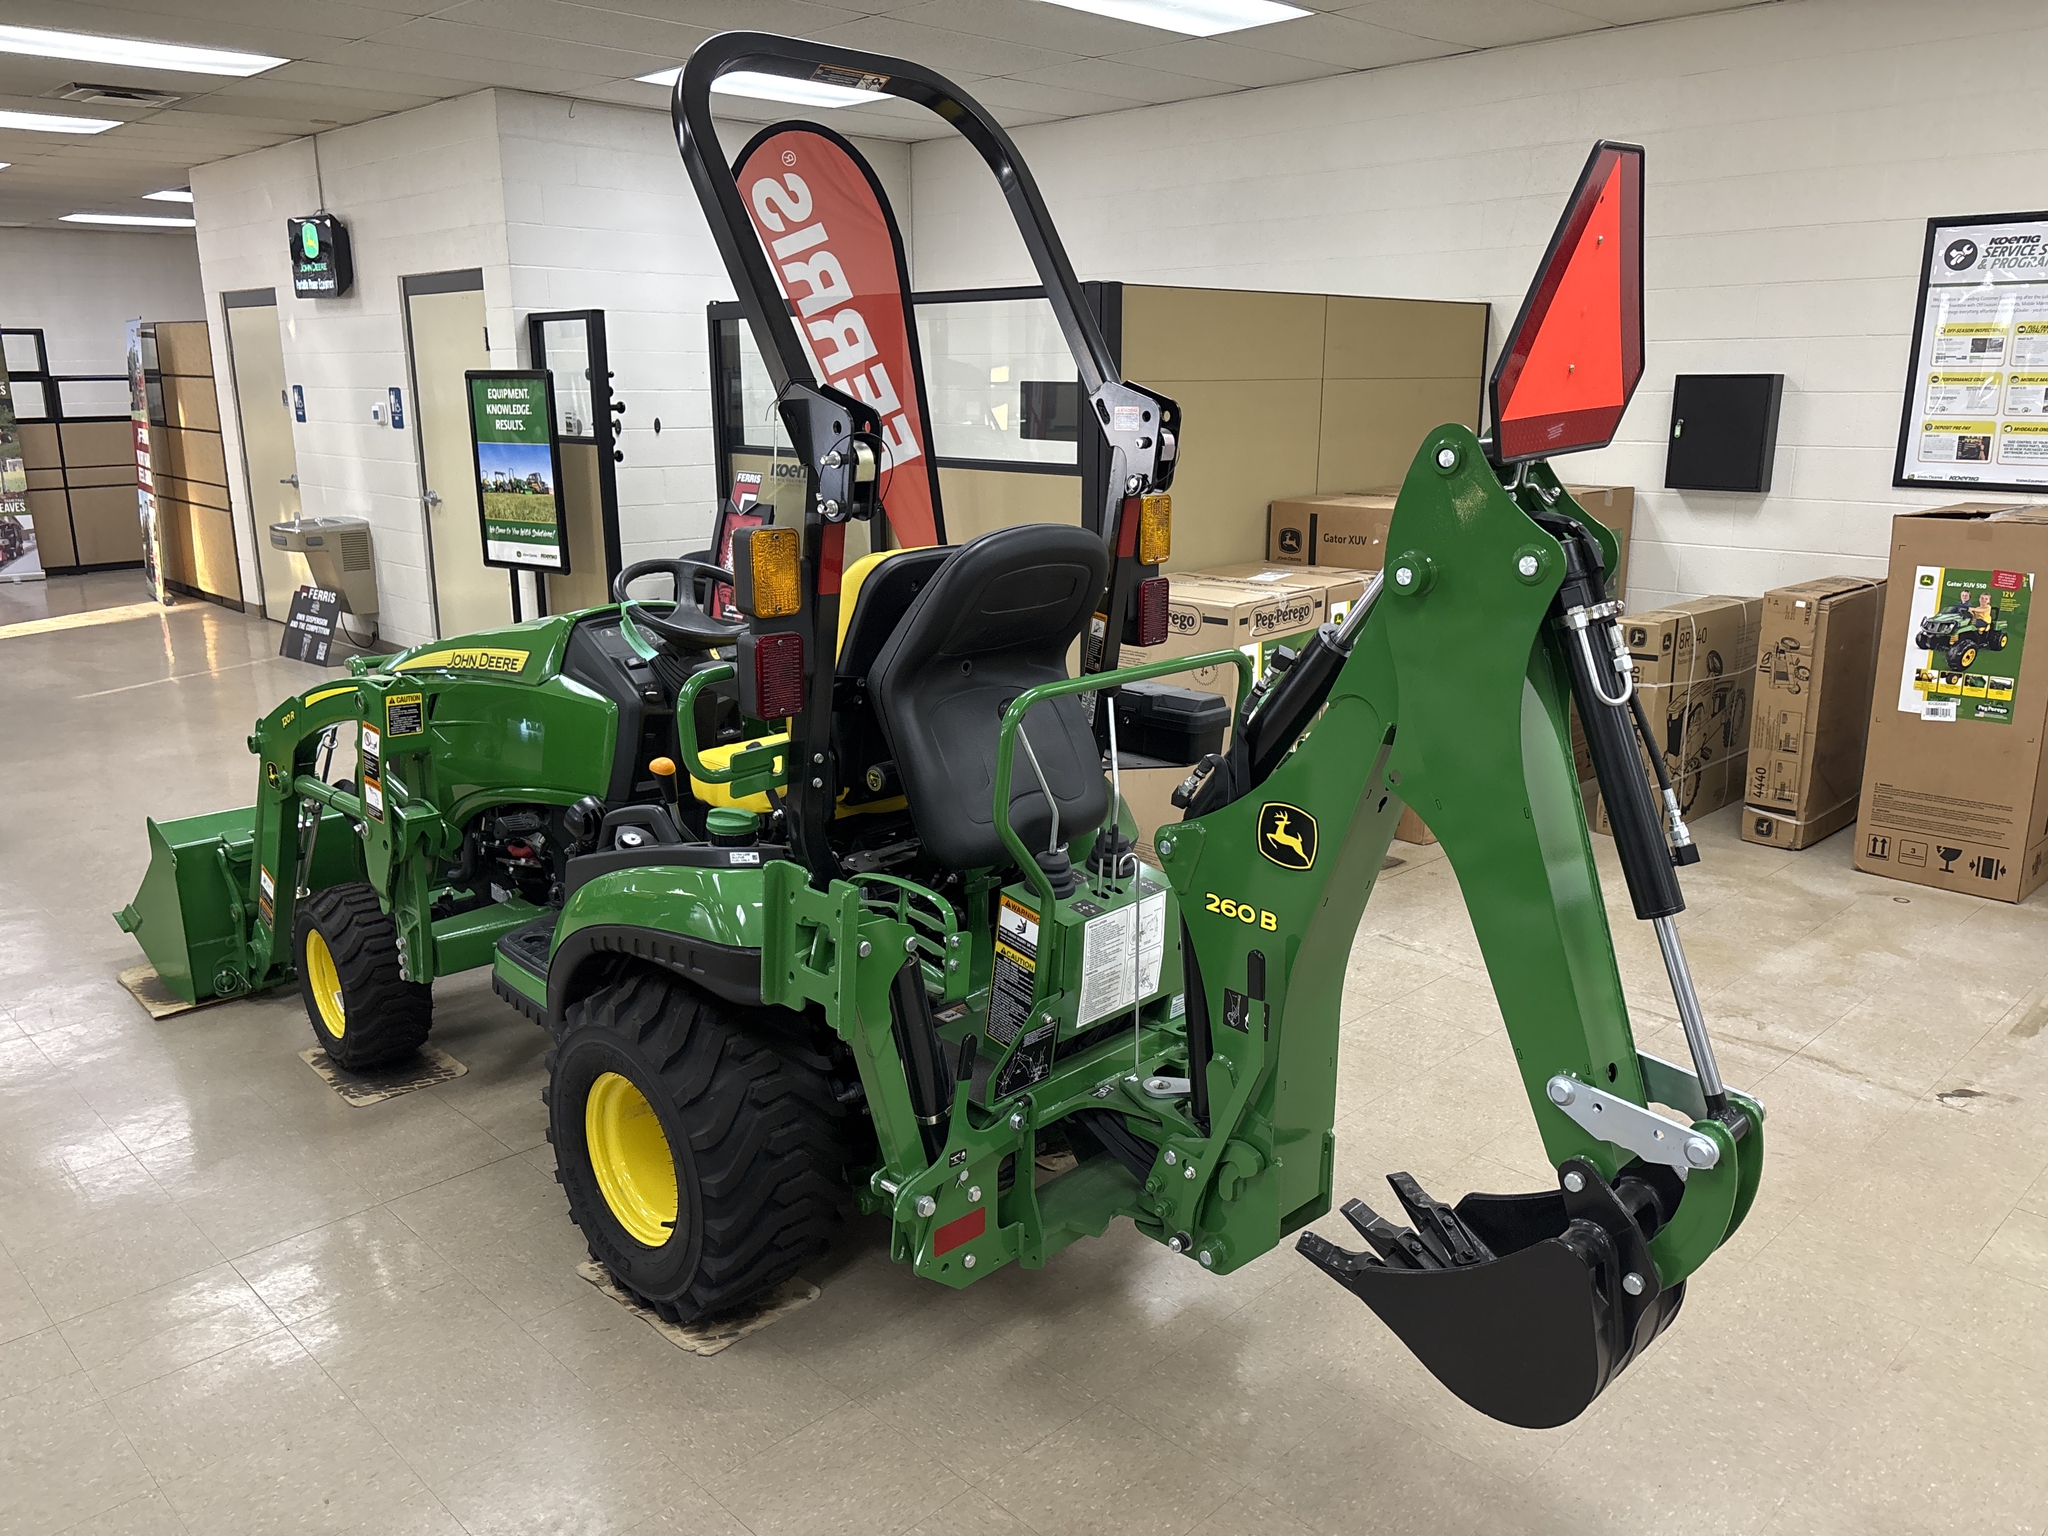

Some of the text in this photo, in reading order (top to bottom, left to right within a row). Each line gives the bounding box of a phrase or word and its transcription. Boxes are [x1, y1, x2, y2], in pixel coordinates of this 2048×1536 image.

[1982, 244, 2039, 258] SERVICE
[1977, 256, 2048, 270] & PROGRA
[488, 388, 530, 400] EQUIPMENT.
[486, 404, 532, 415] KNOWLEDGE.
[495, 419, 526, 431] RESULTS.
[737, 473, 762, 484] FERRIS
[1323, 533, 1367, 546] Gator XUV
[308, 588, 336, 604] FERRIS
[305, 614, 328, 626] SUSPENSION
[290, 620, 298, 628] AND
[306, 623, 330, 636] COMPETITION
[446, 652, 520, 670] JOHN DEERE
[396, 694, 421, 704] CAUTION
[1753, 767, 1766, 798] 4440
[1010, 902, 1040, 924] WARNING
[1205, 892, 1278, 932] 260 B
[1006, 950, 1034, 972] CAUTION
